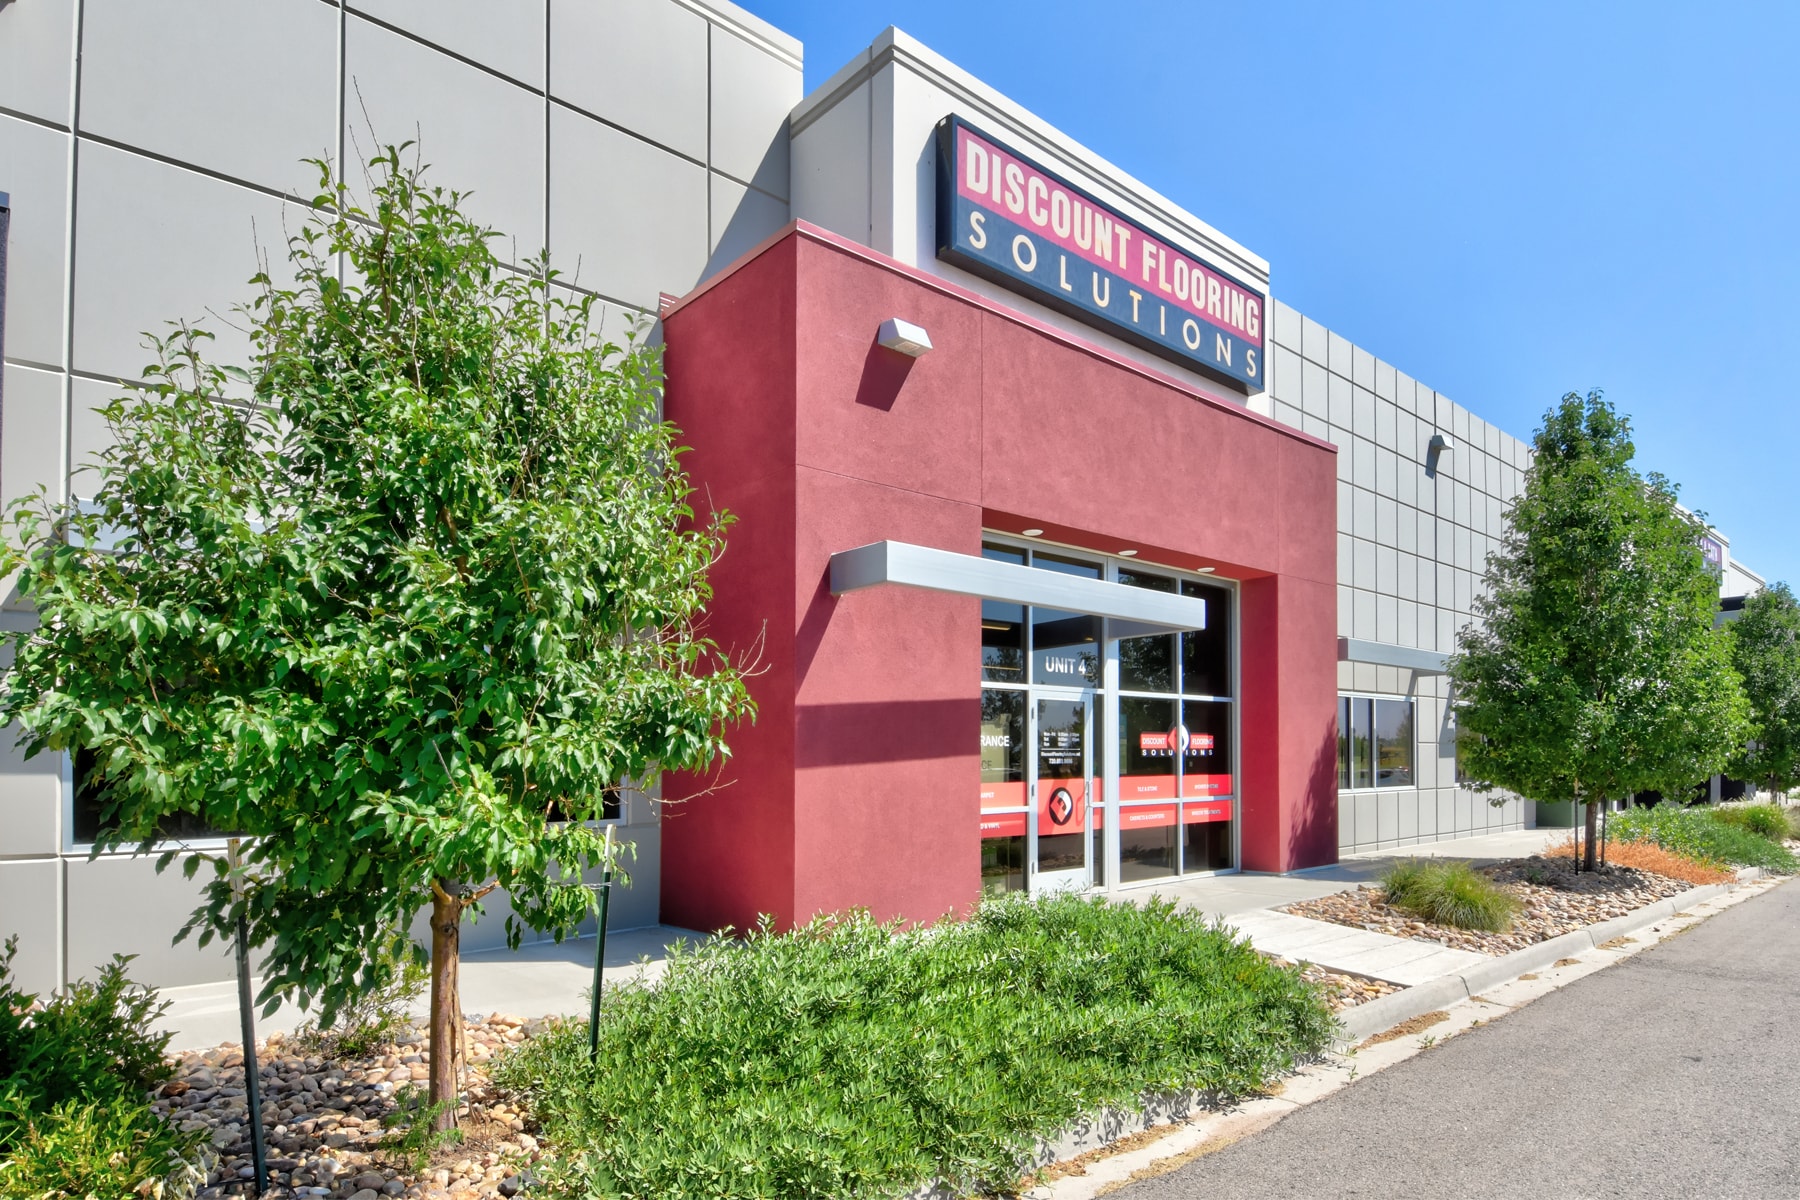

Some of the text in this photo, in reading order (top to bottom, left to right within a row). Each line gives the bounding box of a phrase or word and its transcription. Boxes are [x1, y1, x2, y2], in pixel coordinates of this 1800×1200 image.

[966, 139, 1259, 339] DISCOUNT FLOORING
[968, 211, 1257, 378] SOLUTIONS
[1045, 656, 1087, 675] UNIT 4
[1142, 737, 1165, 745] DISCOUNT
